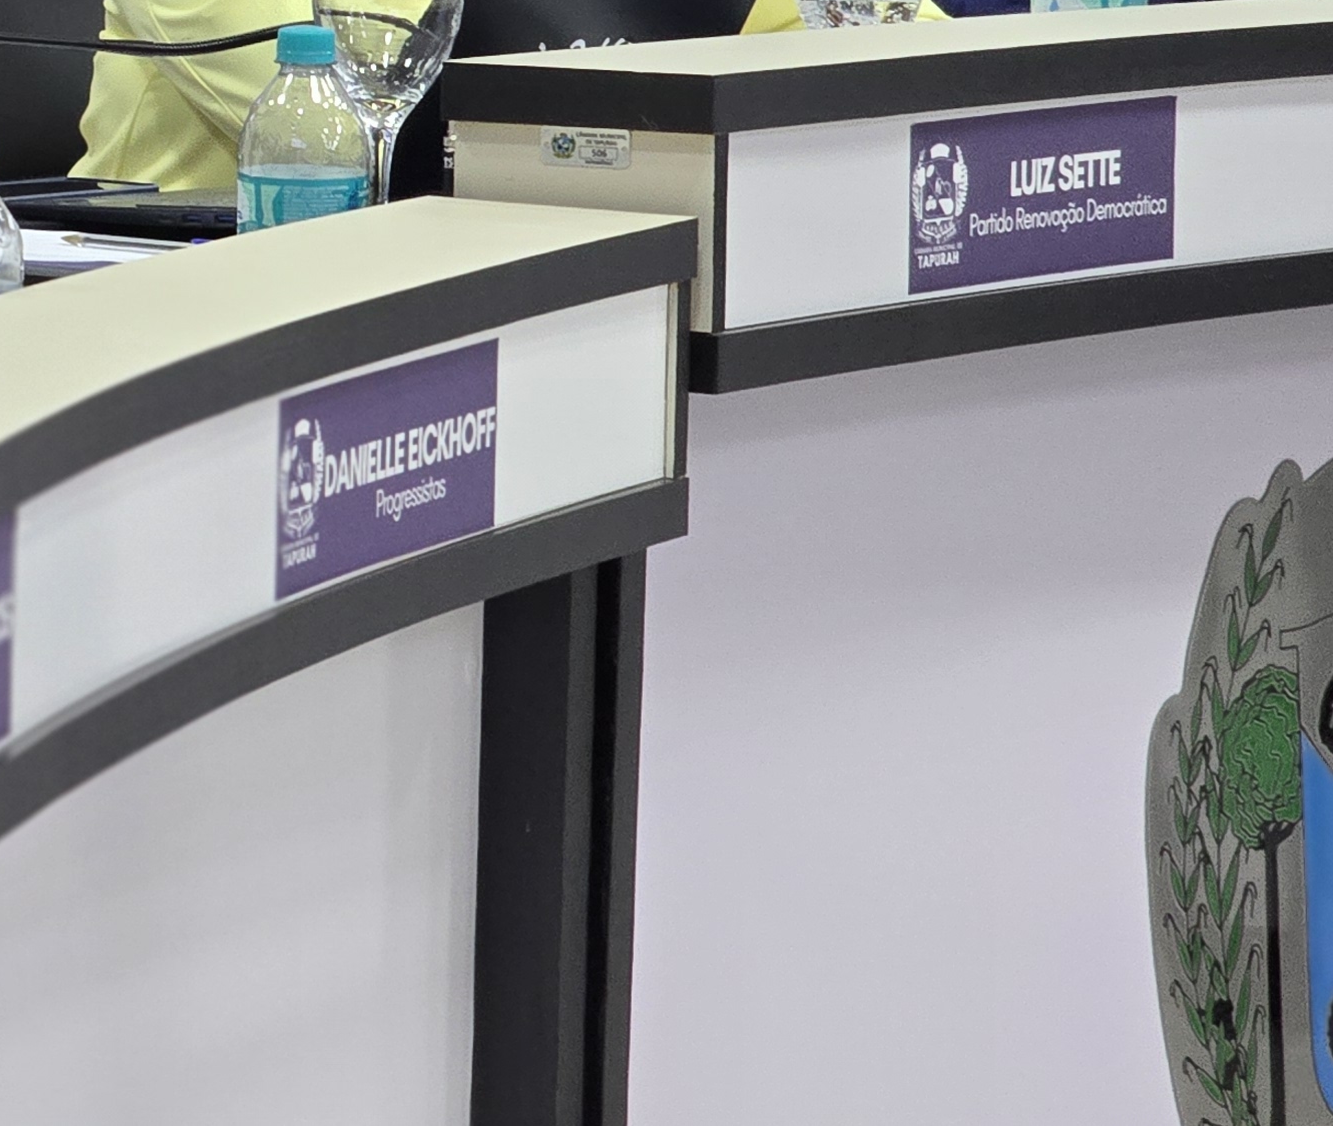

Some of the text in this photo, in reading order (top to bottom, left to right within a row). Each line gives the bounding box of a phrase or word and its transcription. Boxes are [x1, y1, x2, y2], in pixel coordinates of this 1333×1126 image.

[1010, 149, 1121, 197] LUIZ SETTE
[970, 207, 1014, 237] Partido
[1015, 202, 1085, 233] Renovação
[1086, 193, 1167, 222] Democrática
[917, 250, 960, 269] TAPURAH
[323, 406, 496, 498] DANIELLE EICKHOFF
[375, 476, 446, 522] Progressistas
